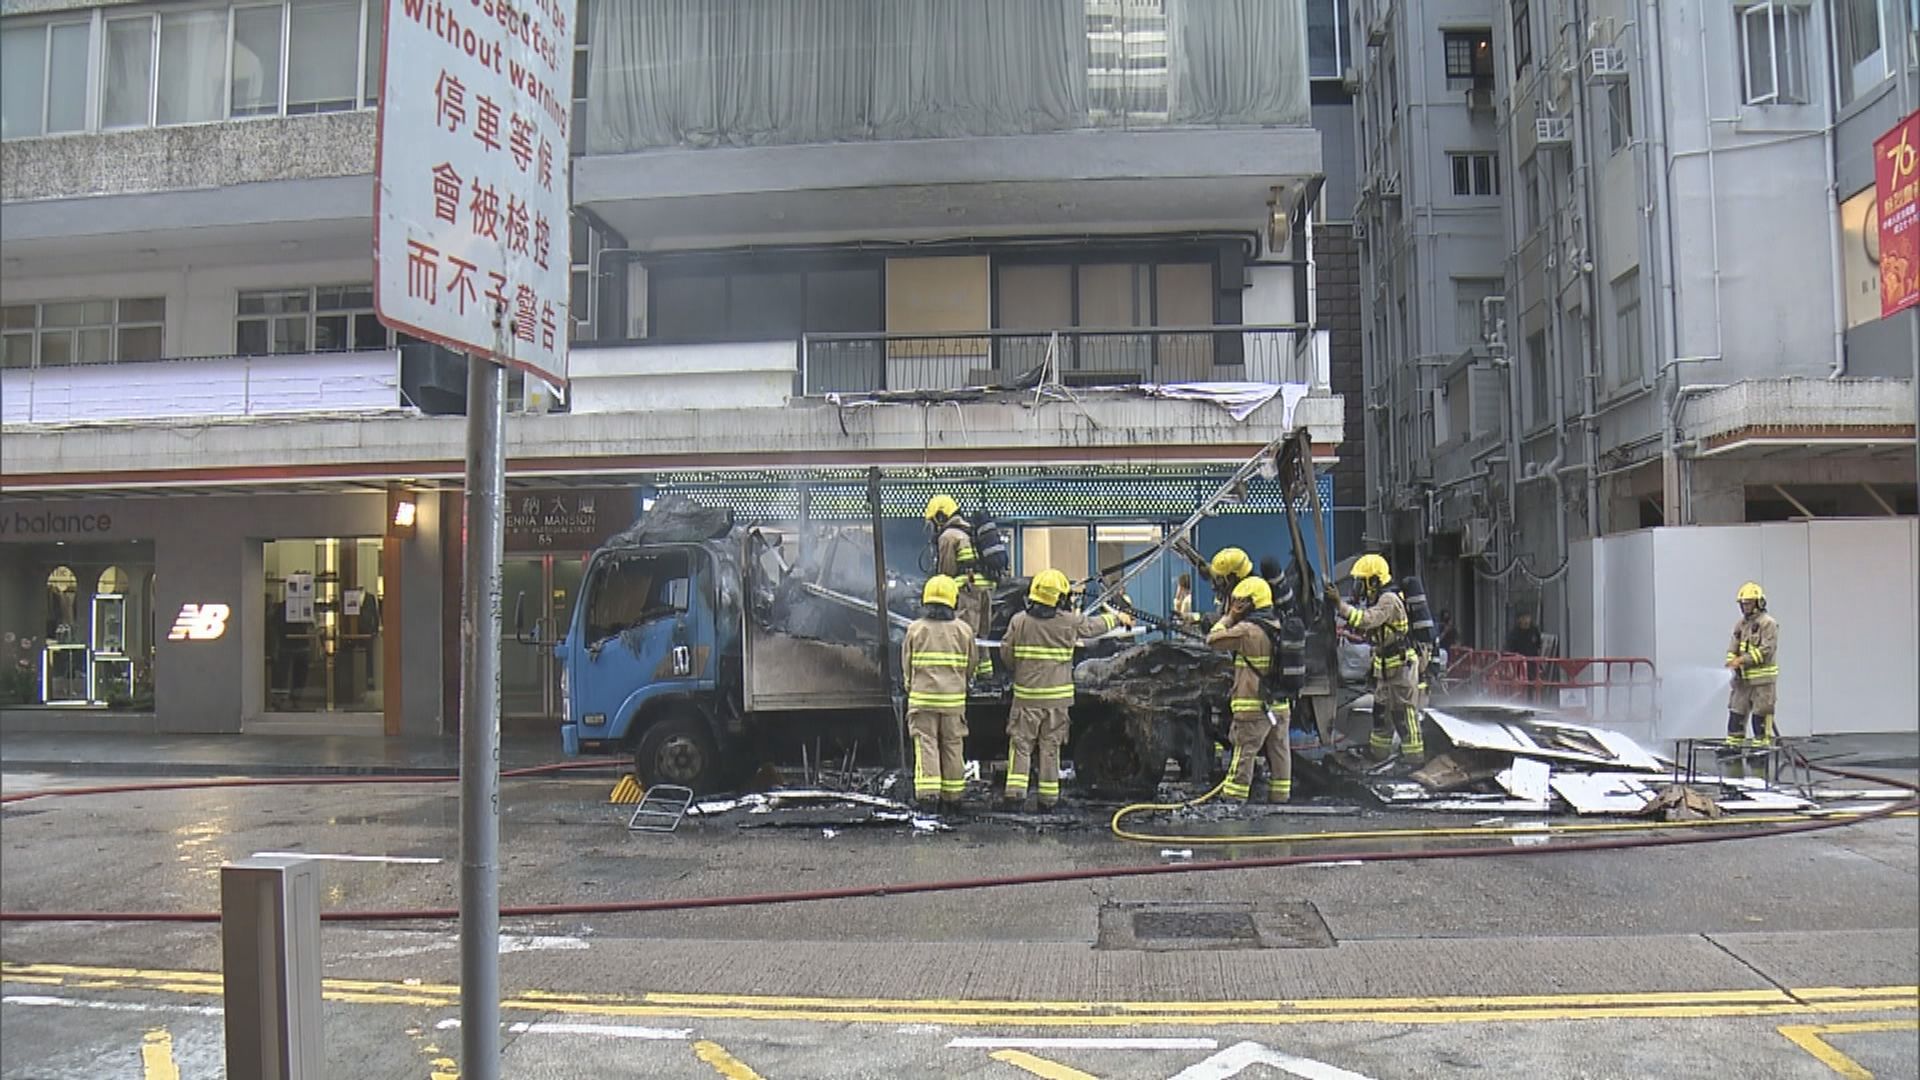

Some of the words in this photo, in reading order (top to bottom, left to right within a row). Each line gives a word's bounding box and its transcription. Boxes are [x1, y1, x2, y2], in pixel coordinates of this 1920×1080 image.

[403, 0, 502, 74] without
[509, 59, 567, 138] warning
[435, 68, 553, 193] 停車等候
[1887, 126, 1918, 191] 76
[432, 161, 550, 270] 會被檢控
[407, 239, 557, 352] 而不予警告
[15, 511, 112, 534] balance
[506, 515, 537, 527] ENNA
[544, 515, 596, 526] MANSION
